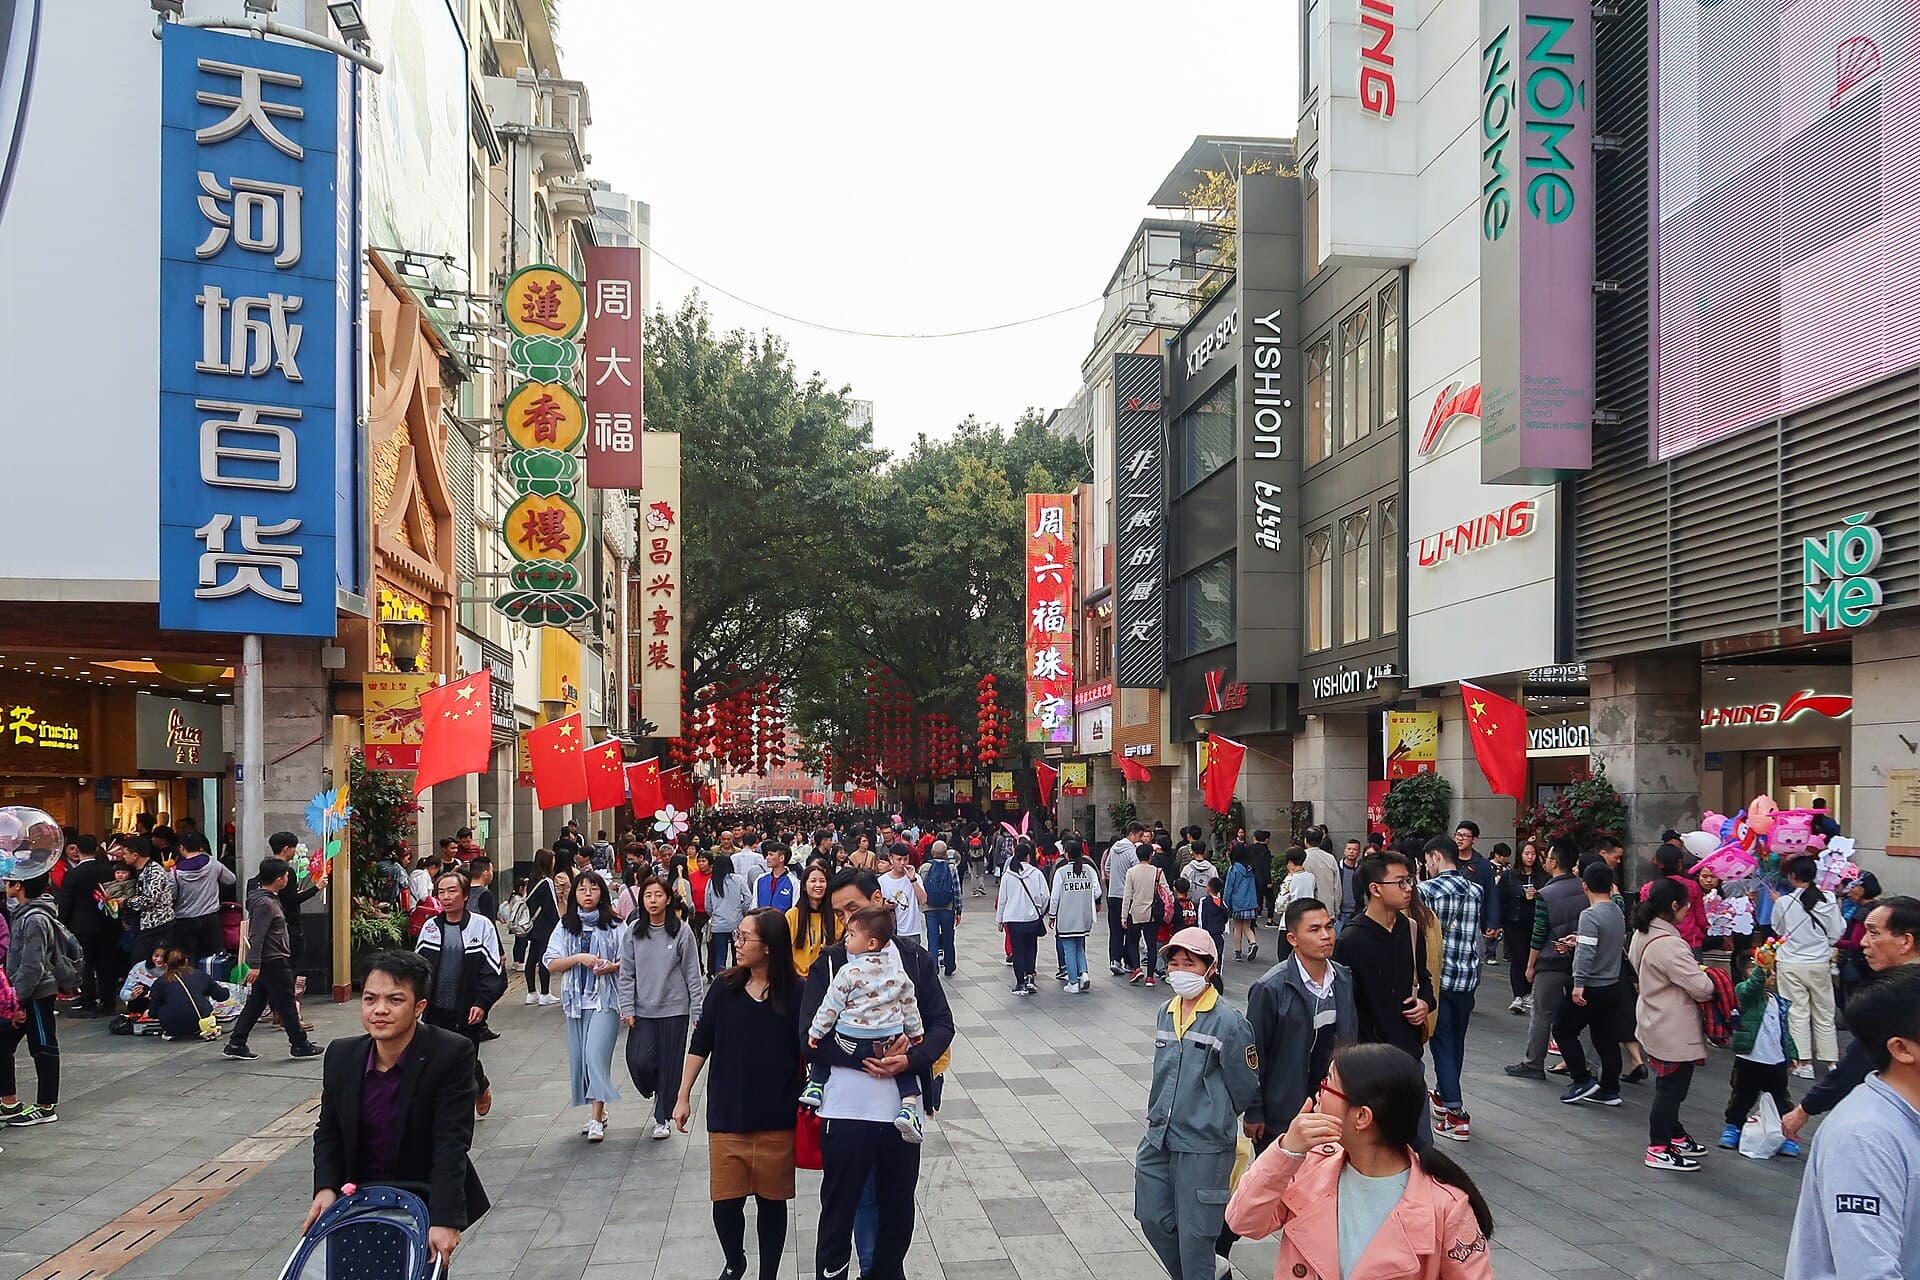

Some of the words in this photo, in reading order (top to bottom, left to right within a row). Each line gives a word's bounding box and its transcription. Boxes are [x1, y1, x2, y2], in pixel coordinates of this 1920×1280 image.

[195, 57, 304, 604] 天河城百货
[594, 279, 635, 454] 周大福
[1185, 332, 1214, 381] XTEP
[518, 279, 571, 554] 蓮香樓
[1419, 501, 1535, 567] LI-NING
[646, 537, 676, 672] 昌兴童装
[1032, 507, 1069, 731] 周六福珠宝
[0, 705, 38, 744] 芒
[1064, 881, 1091, 891] CREAM
[1838, 1196, 1877, 1214] HFQ
